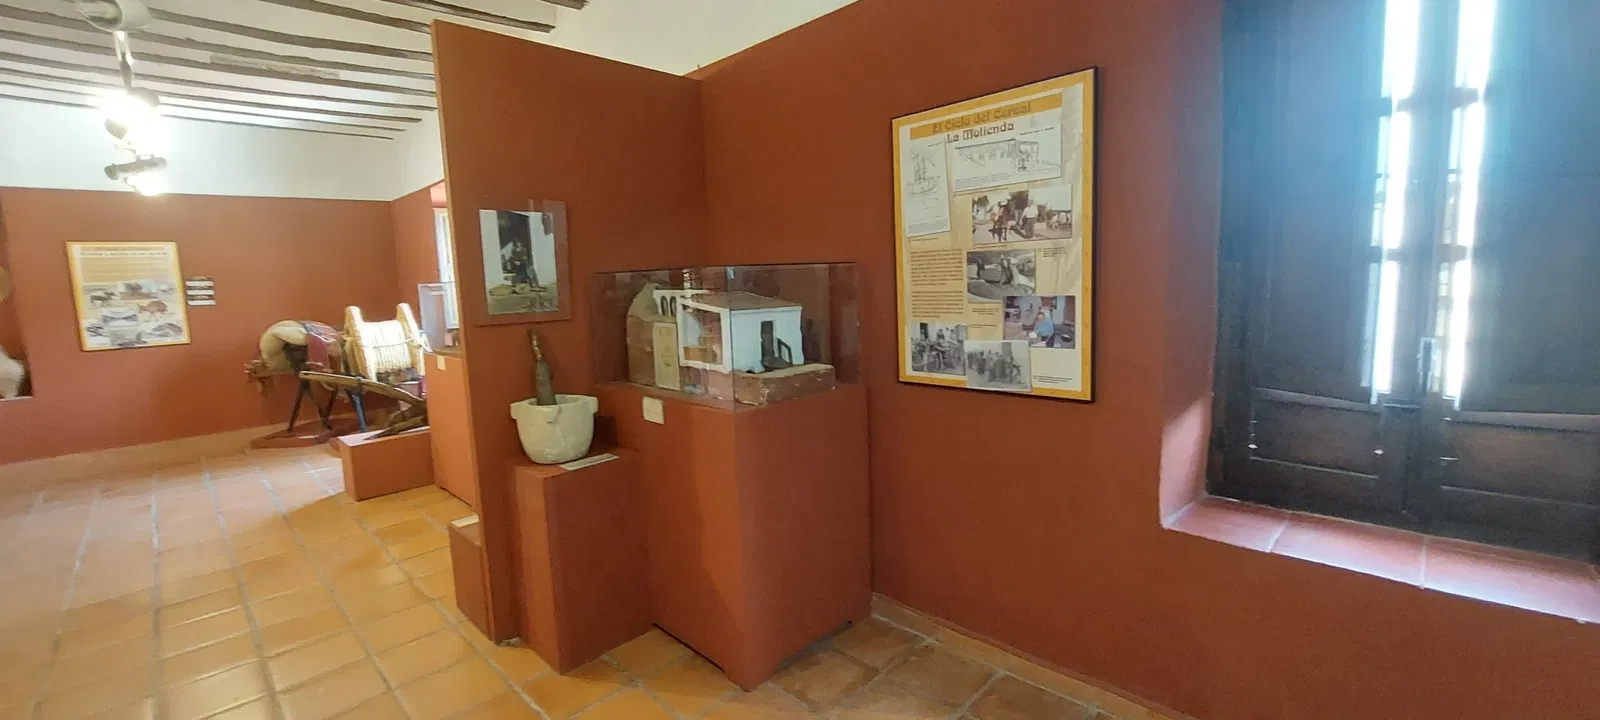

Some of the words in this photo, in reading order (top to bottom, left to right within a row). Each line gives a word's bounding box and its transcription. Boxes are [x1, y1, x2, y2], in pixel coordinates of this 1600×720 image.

[933, 122, 942, 134] El
[945, 116, 971, 130] Ciclo
[974, 111, 990, 123] del
[994, 101, 1031, 119] Cereal
[947, 133, 959, 143] La
[963, 121, 1014, 140] Molienda
